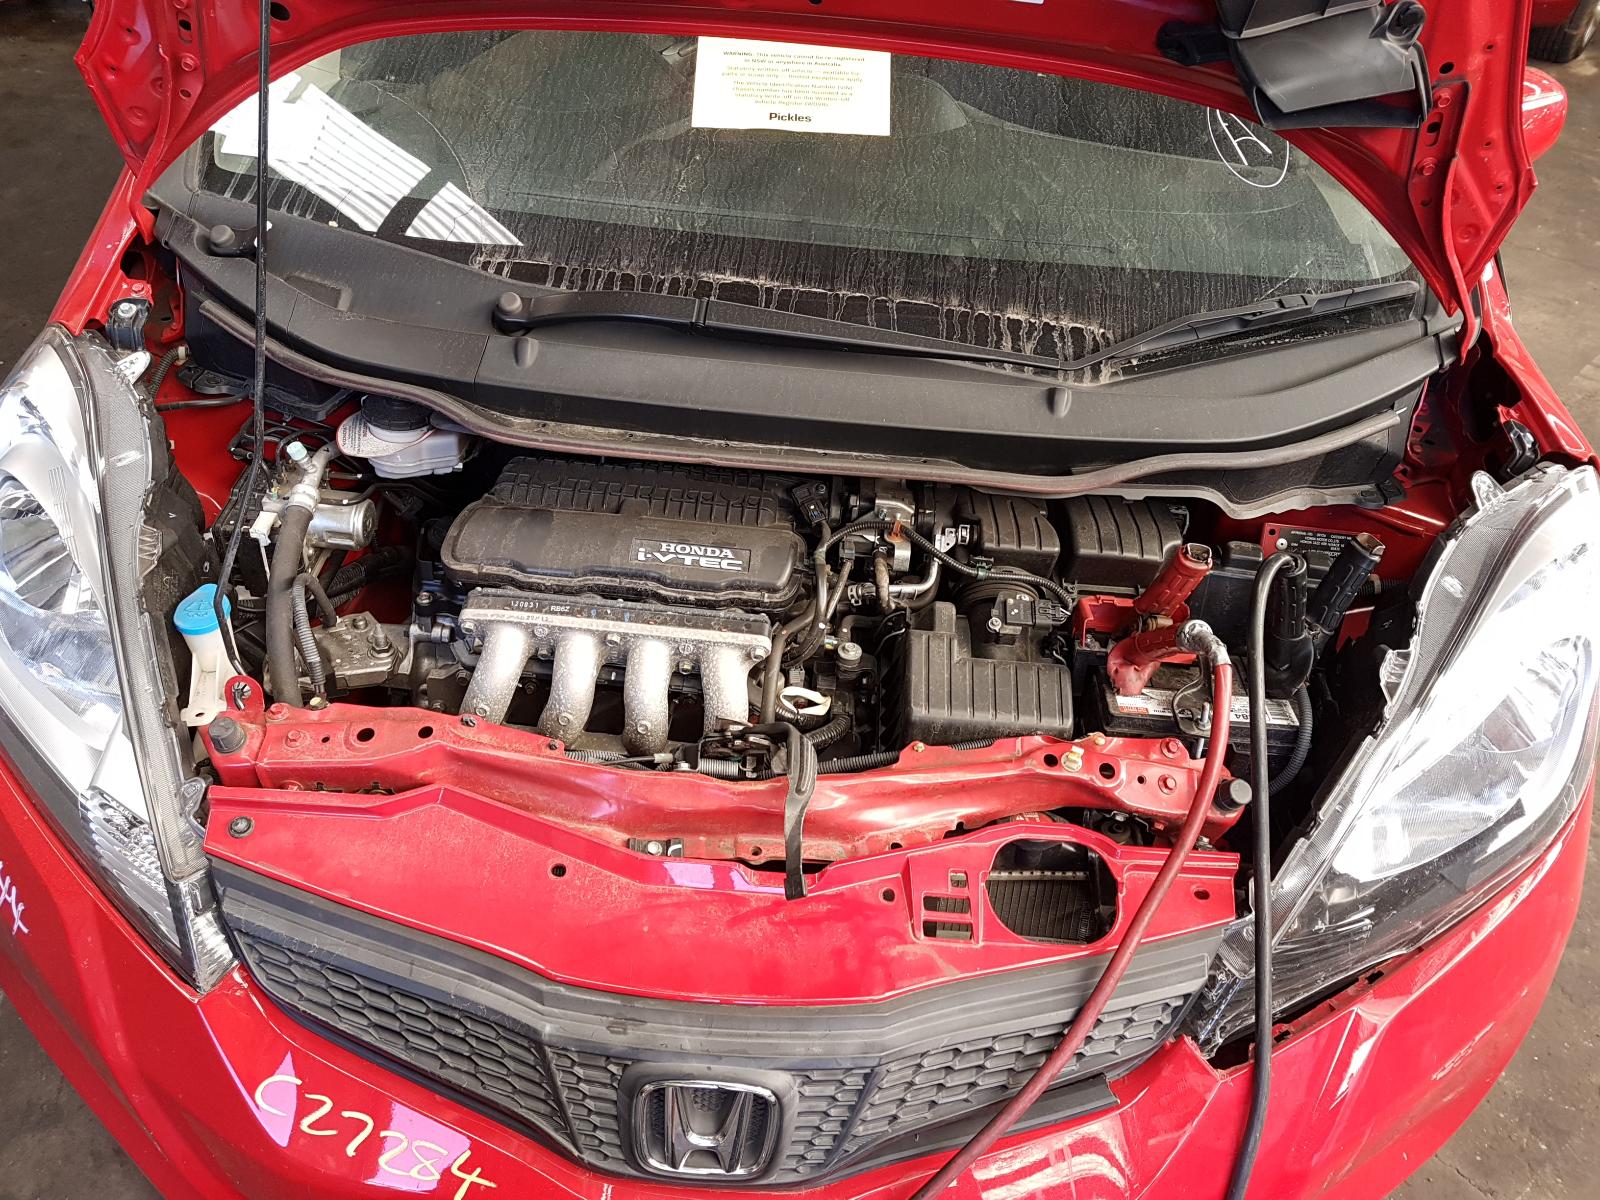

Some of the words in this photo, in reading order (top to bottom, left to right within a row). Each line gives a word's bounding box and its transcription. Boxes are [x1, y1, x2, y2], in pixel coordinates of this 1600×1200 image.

[769, 112, 812, 122] Pickles
[660, 542, 736, 559] HONDA
[254, 1073, 497, 1200] C27284
